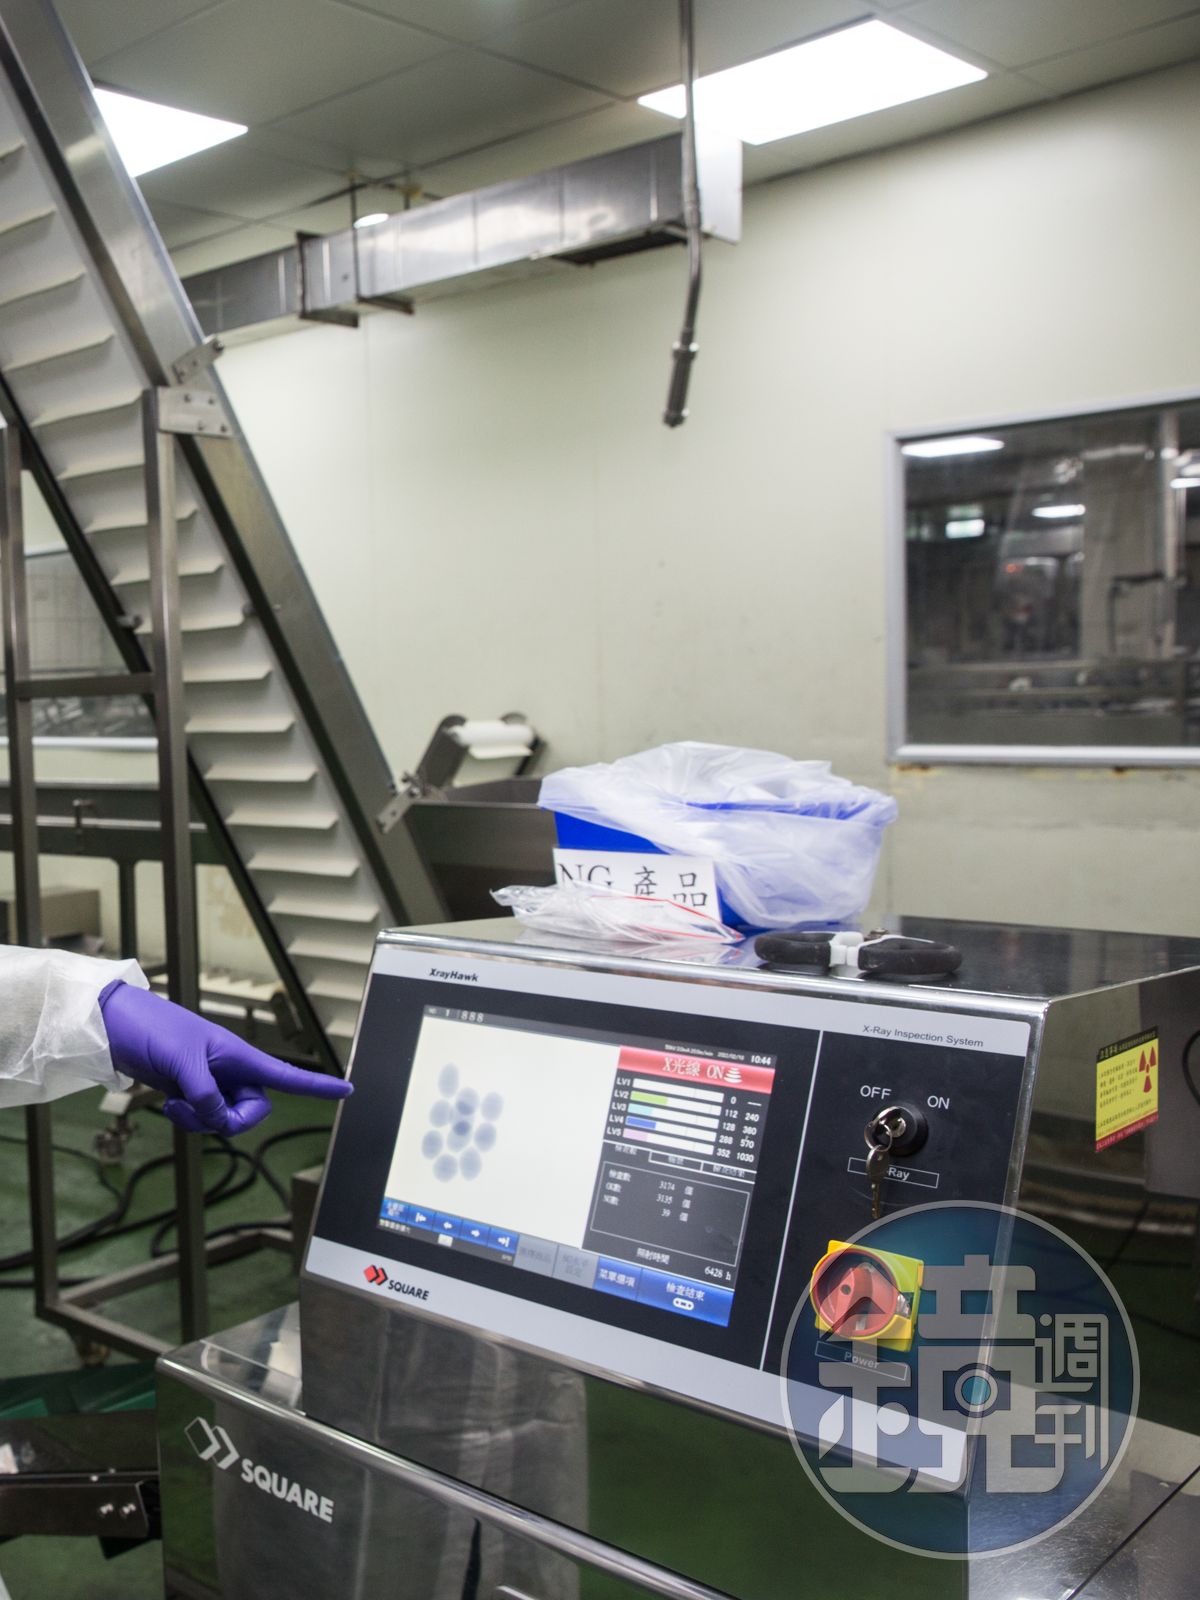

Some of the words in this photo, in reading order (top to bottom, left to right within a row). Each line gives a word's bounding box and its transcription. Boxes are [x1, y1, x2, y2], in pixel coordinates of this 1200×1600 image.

[557, 863, 612, 887] NG
[634, 866, 708, 907] 產品
[429, 968, 478, 982] XrayHawk
[863, 1025, 892, 1037] X-Ray
[894, 1029, 943, 1042] Inspection
[947, 1035, 984, 1048] System
[751, 1055, 771, 1065] 10:44
[707, 1064, 725, 1080] ON
[616, 1077, 631, 1087] LV1
[730, 1096, 737, 1105] 0
[860, 1085, 892, 1100] OFF
[614, 1089, 629, 1099] LV2
[725, 1109, 738, 1119] 112
[744, 1113, 760, 1122] 240
[927, 1095, 950, 1110] ON
[612, 1102, 627, 1112] LV3
[722, 1122, 736, 1132] 128
[609, 1115, 624, 1124] LV4
[740, 1139, 754, 1149] 570
[607, 1127, 622, 1137] LV5
[716, 1148, 730, 1158] 352
[736, 1152, 754, 1162] 1030
[886, 1167, 910, 1181] -Ray
[704, 1265, 723, 1279] 6428
[725, 1271, 732, 1280] h
[387, 1279, 429, 1301] SQUARE
[844, 1351, 880, 1370] Power
[241, 1457, 335, 1524] SQUARE
